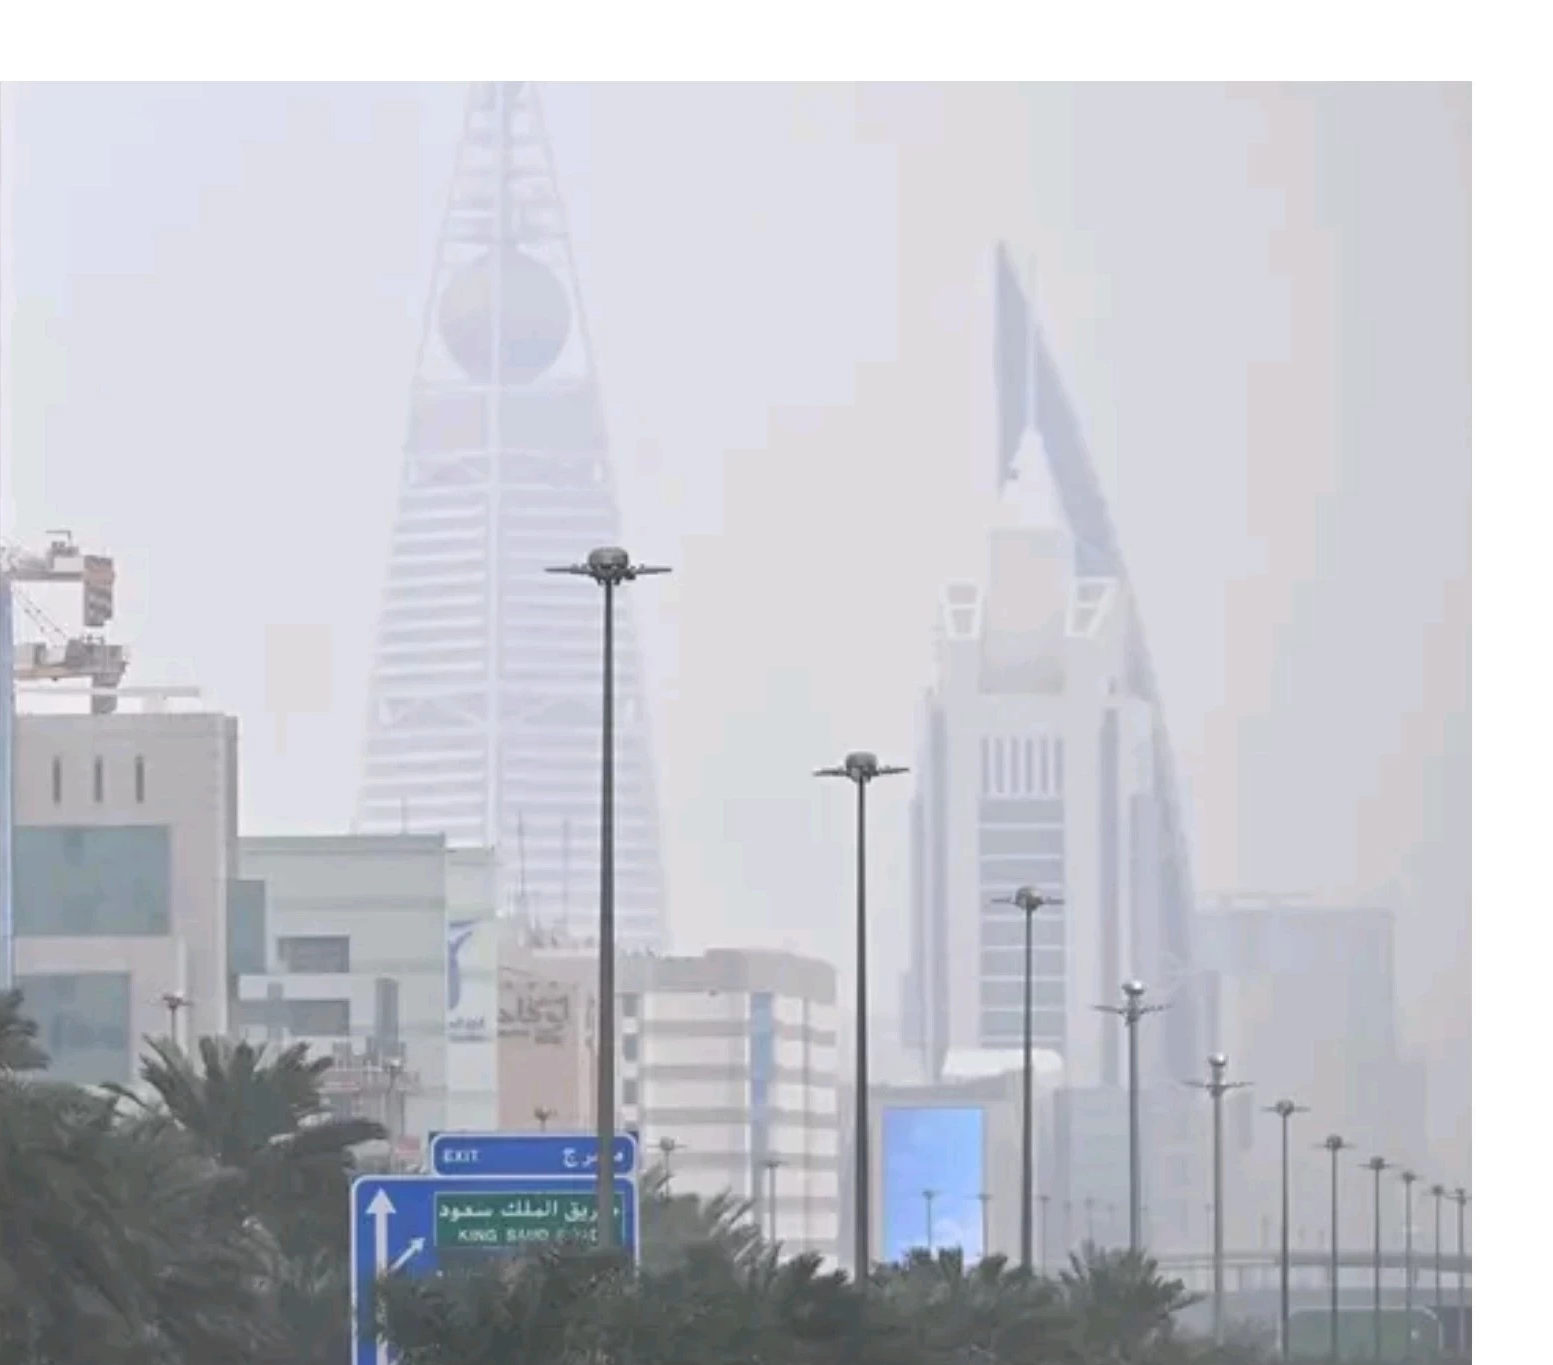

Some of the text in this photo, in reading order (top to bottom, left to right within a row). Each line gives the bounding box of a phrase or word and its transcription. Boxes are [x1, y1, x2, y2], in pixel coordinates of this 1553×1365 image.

[443, 1148, 479, 1163] EXIT
[562, 1147, 624, 1168] مرج
[439, 1199, 620, 1223] ريق الملك سعود
[457, 1228, 498, 1242] KING
